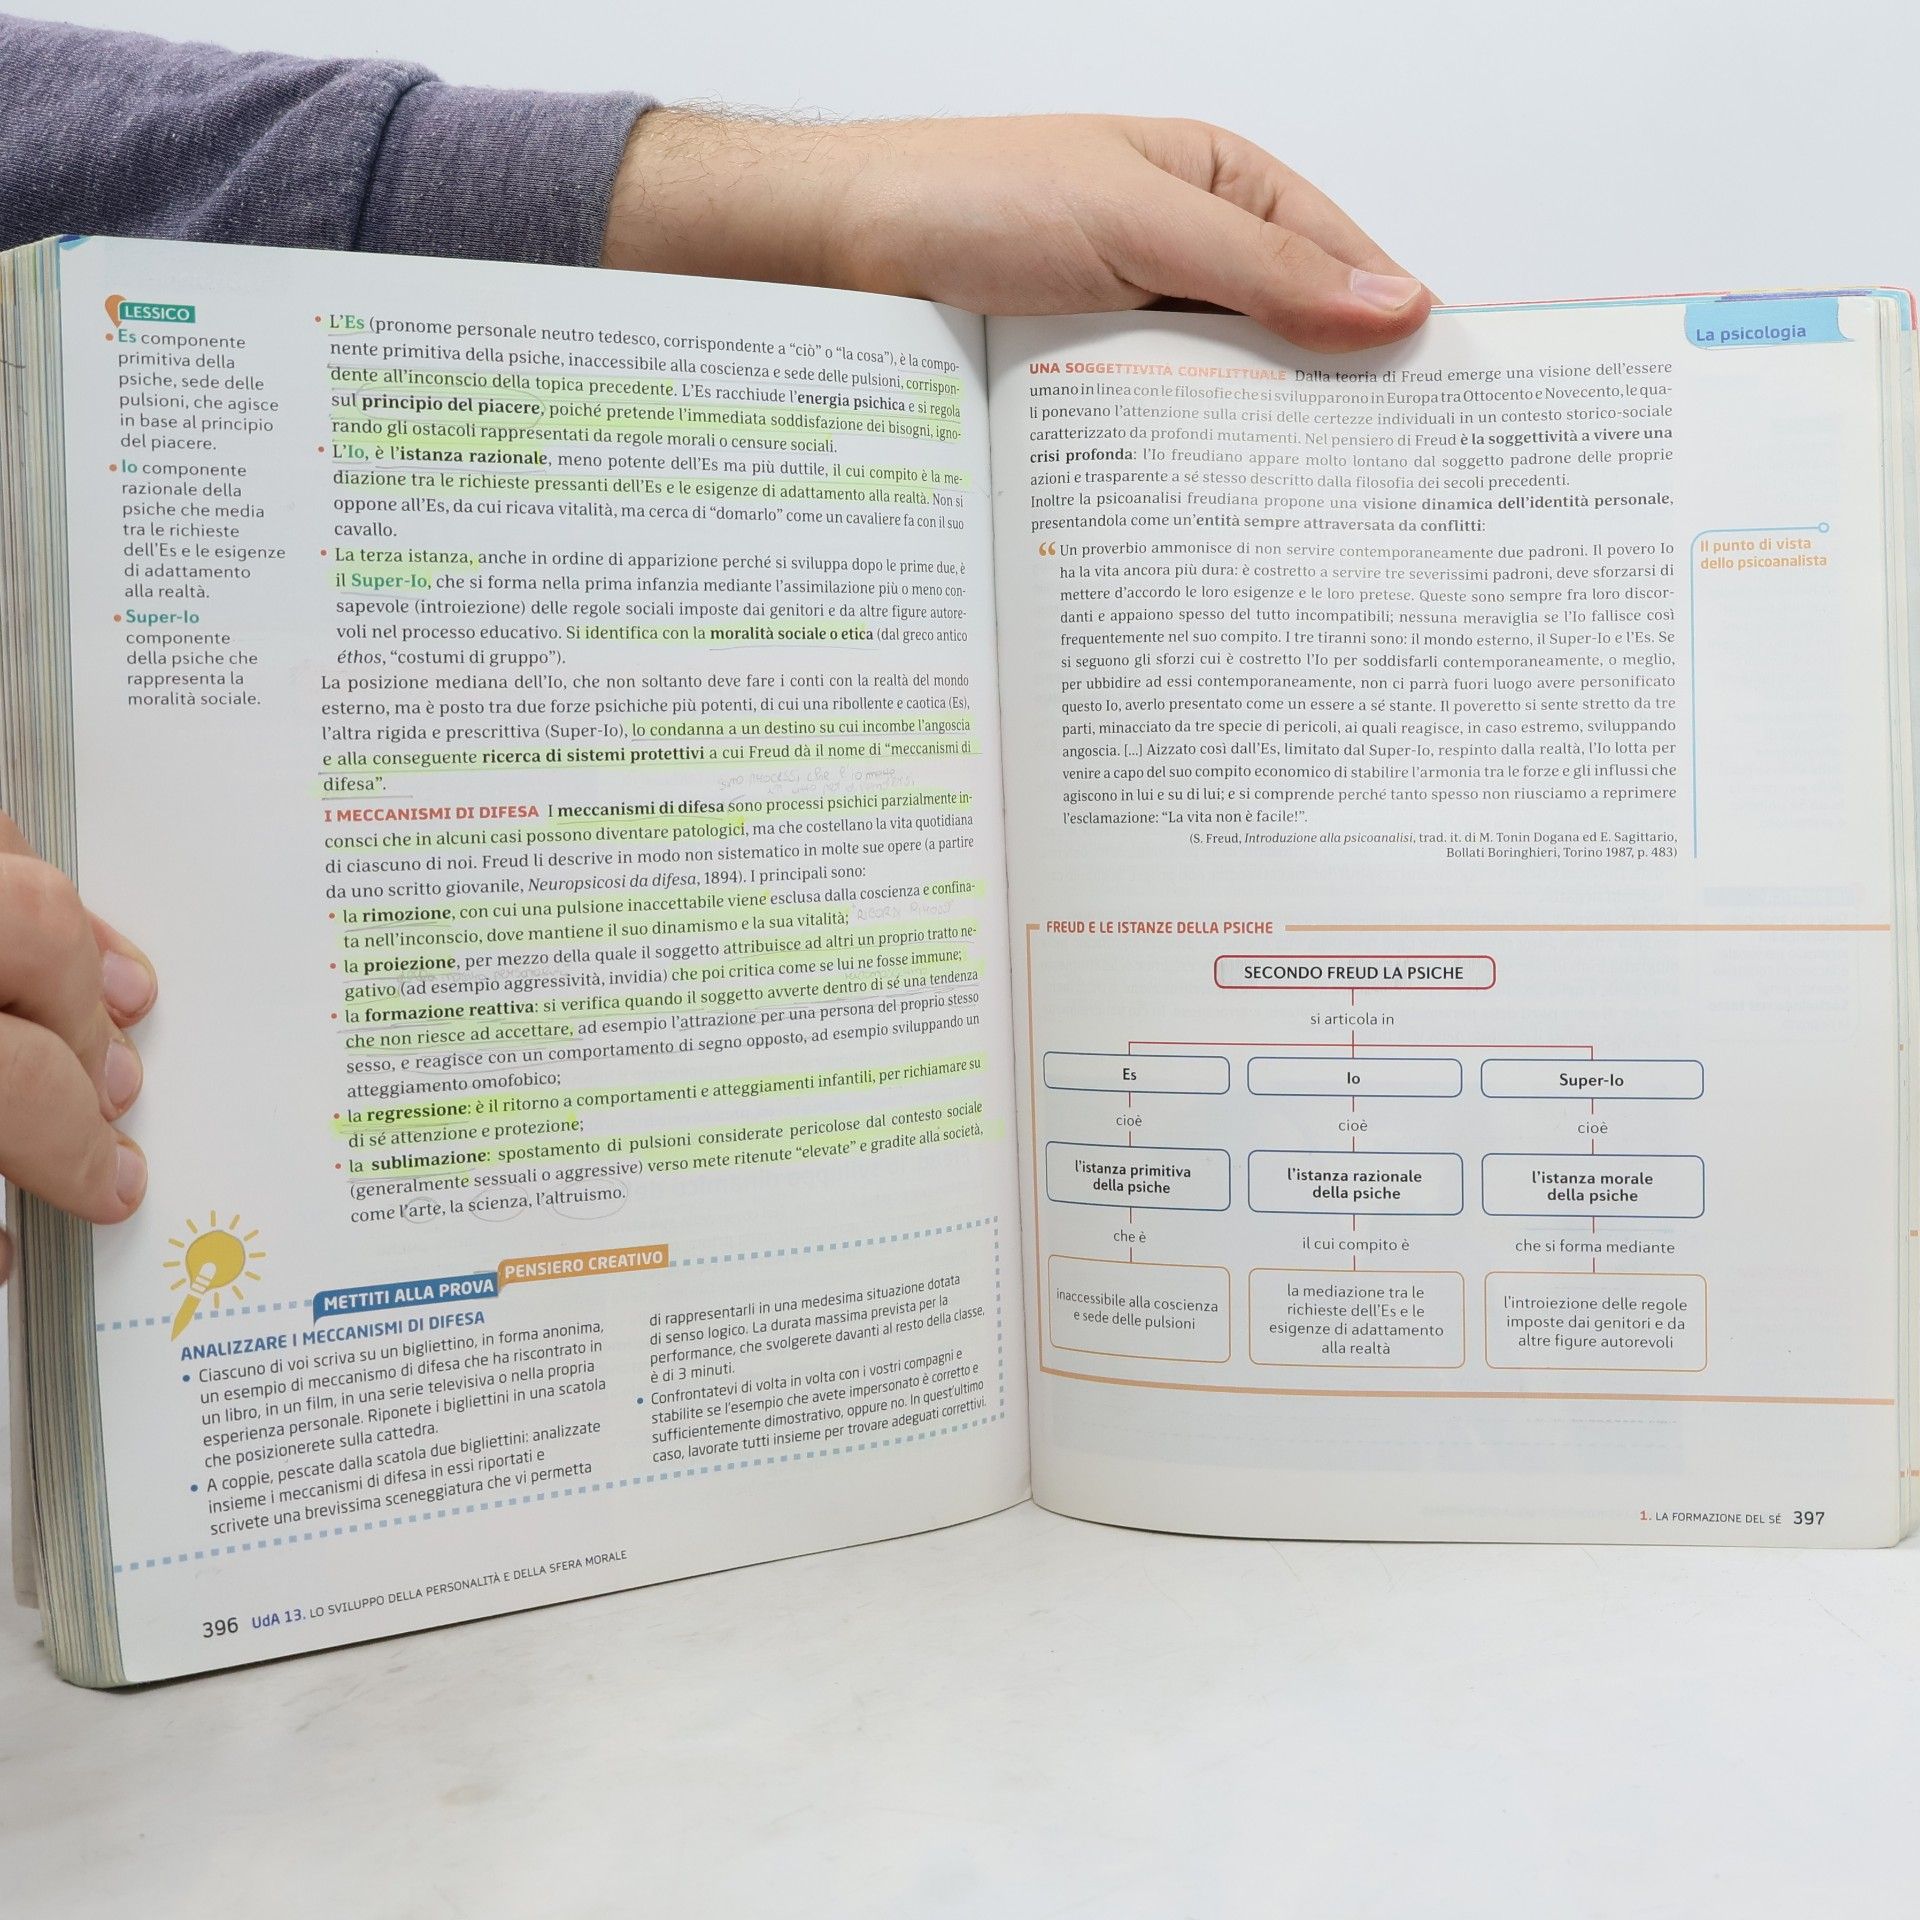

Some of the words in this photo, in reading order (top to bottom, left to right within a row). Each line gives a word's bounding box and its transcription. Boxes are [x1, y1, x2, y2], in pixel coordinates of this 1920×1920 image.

[123, 304, 191, 322] LESSICO
[118, 329, 136, 343] Es
[140, 335, 246, 350] componente
[1696, 329, 1715, 342] La
[1720, 325, 1807, 344] psicologia
[118, 352, 191, 368] primitiva
[195, 353, 235, 369] della
[1028, 362, 1062, 376] UNA
[1064, 362, 1173, 377] SOGGETTIVITÀ
[1177, 367, 1288, 382] CONFLITTUALE
[118, 372, 177, 389] psiche,
[181, 374, 220, 389] sede
[224, 375, 265, 391] delle
[119, 392, 189, 410] pulsioni,
[193, 395, 224, 410] che
[227, 398, 279, 415] agisce
[121, 413, 134, 426] in
[139, 413, 178, 429] base
[183, 415, 197, 429] al
[201, 417, 274, 435] principio
[121, 433, 146, 448] del
[151, 436, 217, 452] piacere.
[1700, 540, 1708, 552] Il
[1712, 541, 1755, 554] punto
[1760, 539, 1772, 550] di
[1776, 538, 1813, 550] vista
[1700, 557, 1735, 570] dello
[1737, 555, 1829, 571] psicoanalista
[125, 609, 200, 628] Super-Io
[125, 634, 231, 649] componente
[126, 650, 168, 665] della
[171, 651, 225, 669] psiche
[228, 651, 258, 665] che
[336, 650, 387, 667] éthos,
[390, 650, 466, 665] “costumi
[469, 650, 485, 664] di
[488, 650, 566, 668] gruppo”).
[127, 674, 226, 689] rappresenta
[231, 671, 243, 685] la
[128, 691, 196, 706] moralità
[200, 691, 261, 706] sociale.
[325, 810, 332, 822] I
[335, 807, 453, 823] MECCANISMI
[456, 807, 474, 820] DI
[479, 805, 540, 820] DIFESA
[1446, 848, 1485, 858] Bollati
[1487, 847, 1561, 861] Boringhieri,
[1562, 847, 1603, 858] Torino
[1605, 847, 1635, 859] 1987,
[1638, 850, 1647, 859] p.
[1650, 847, 1678, 859] 483)
[1046, 920, 1086, 934] FREUD
[1088, 921, 1096, 933] E
[1100, 921, 1114, 934] LE
[1117, 920, 1173, 935] ISTANZE
[1175, 921, 1221, 935] DELLA
[1223, 921, 1274, 935] PSICHE
[1243, 966, 1323, 981] SECONDO
[1325, 966, 1379, 980] FREUD
[1382, 967, 1403, 979] LA
[1406, 967, 1464, 980] PSICHE
[1311, 1013, 1320, 1024] si
[1324, 1012, 1378, 1026] articola
[1382, 1013, 1394, 1025] in
[1122, 1068, 1136, 1080] Es
[1347, 1072, 1360, 1084] Io
[1559, 1073, 1625, 1091] Super-Io
[1114, 1114, 1144, 1127] cioè
[1337, 1119, 1368, 1132] cioè
[1577, 1122, 1609, 1135] cioè
[1130, 1164, 1192, 1180] primitiva
[1350, 1170, 1424, 1183] razionale
[1600, 1172, 1654, 1186] morale
[1092, 1178, 1124, 1192] della
[1127, 1179, 1171, 1196] psiche
[1312, 1185, 1350, 1200] della
[1353, 1186, 1401, 1203] psiche
[1546, 1188, 1585, 1202] della
[1589, 1189, 1639, 1205] psiche
[1114, 1229, 1135, 1242] che
[1139, 1231, 1146, 1243] è
[1303, 1236, 1310, 1249] il
[1314, 1238, 1334, 1249] cui
[1337, 1239, 1398, 1254] compito
[1401, 1239, 1409, 1251] è
[1516, 1239, 1541, 1251] che
[1545, 1240, 1555, 1251] si
[1559, 1239, 1602, 1253] forma
[1606, 1240, 1676, 1254] mediante
[505, 1259, 584, 1279] PENSIERO
[588, 1252, 663, 1270] CREATIVO
[324, 1291, 390, 1311] METTITI
[394, 1286, 435, 1303] ALLA
[439, 1279, 494, 1298] PROVA
[1288, 1283, 1298, 1296] la
[1303, 1285, 1385, 1299] mediazione
[1389, 1288, 1407, 1298] tra
[1413, 1286, 1424, 1298] le
[1056, 1288, 1126, 1307] inaccessibile
[1129, 1294, 1151, 1308] alla
[1153, 1299, 1219, 1313] coscienza
[1601, 1297, 1638, 1311] delle
[1641, 1298, 1688, 1315] regole
[1287, 1302, 1348, 1317] richieste
[1398, 1305, 1408, 1318] e
[1413, 1304, 1424, 1317] le
[1073, 1312, 1080, 1320] e
[1081, 1311, 1111, 1324] sede
[1111, 1312, 1142, 1327] delle
[1144, 1315, 1197, 1331] pulsioni
[1269, 1322, 1331, 1338] esigenze
[1335, 1322, 1347, 1335] di
[1351, 1323, 1444, 1337] adattamento
[1506, 1316, 1565, 1332] imposte
[1569, 1315, 1589, 1328] dai
[1594, 1317, 1651, 1333] genitori
[1655, 1320, 1664, 1330] e
[1668, 1317, 1684, 1329] da
[180, 1335, 288, 1362] ANALIZZARE
[293, 1333, 297, 1347] I
[302, 1321, 403, 1346] MECCANISMI
[408, 1318, 423, 1332] DI
[428, 1311, 486, 1331] DIFESA
[1518, 1333, 1551, 1347] altre
[1554, 1334, 1598, 1351] figure
[1600, 1335, 1673, 1349] autorevoli
[1322, 1341, 1345, 1354] alla
[1350, 1342, 1391, 1355] realtà
[1640, 1510, 1651, 1520] 1.
[1656, 1512, 1668, 1521] LA
[1671, 1512, 1742, 1524] FORMAZIONE
[1746, 1514, 1765, 1523] DEL
[1769, 1513, 1781, 1524] SÉ
[1793, 1511, 1826, 1526] 397
[202, 1617, 239, 1639] 396
[250, 1613, 281, 1630] UdA
[284, 1609, 306, 1623] 13.
[310, 1607, 324, 1618] LO
[327, 1596, 385, 1616] SVILUPPO
[387, 1589, 424, 1604] DELLA
[425, 1572, 501, 1597] PERSONALITÀ
[504, 1572, 510, 1581] E
[513, 1566, 548, 1580] DELLA
[548, 1559, 583, 1576] SFERA
[584, 1550, 628, 1567] MORALE
